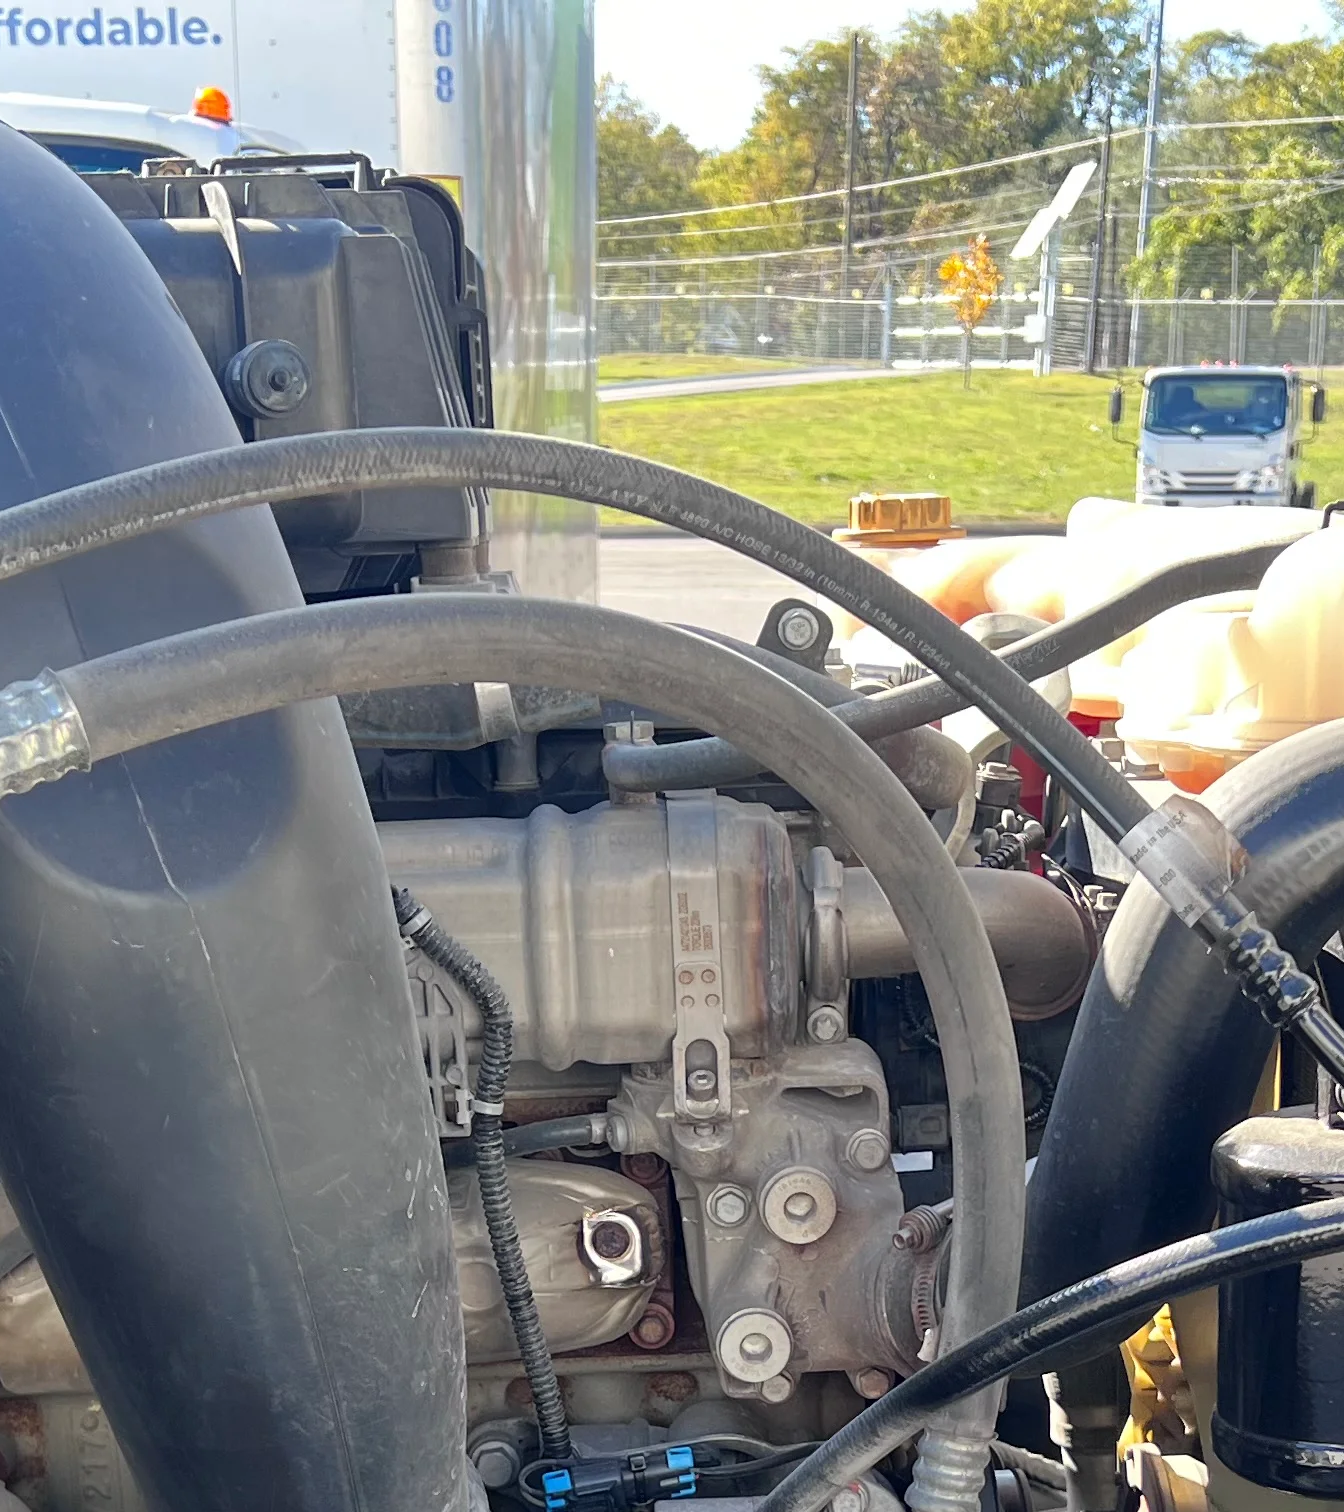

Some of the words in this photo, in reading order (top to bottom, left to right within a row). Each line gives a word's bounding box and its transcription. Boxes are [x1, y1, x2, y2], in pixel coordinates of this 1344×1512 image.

[711, 522, 734, 540] A/C
[734, 530, 773, 557] HOSE
[773, 549, 805, 574] 13/32
[805, 565, 816, 580] in
[859, 599, 899, 634] R-134a
[1167, 810, 1188, 830] USA
